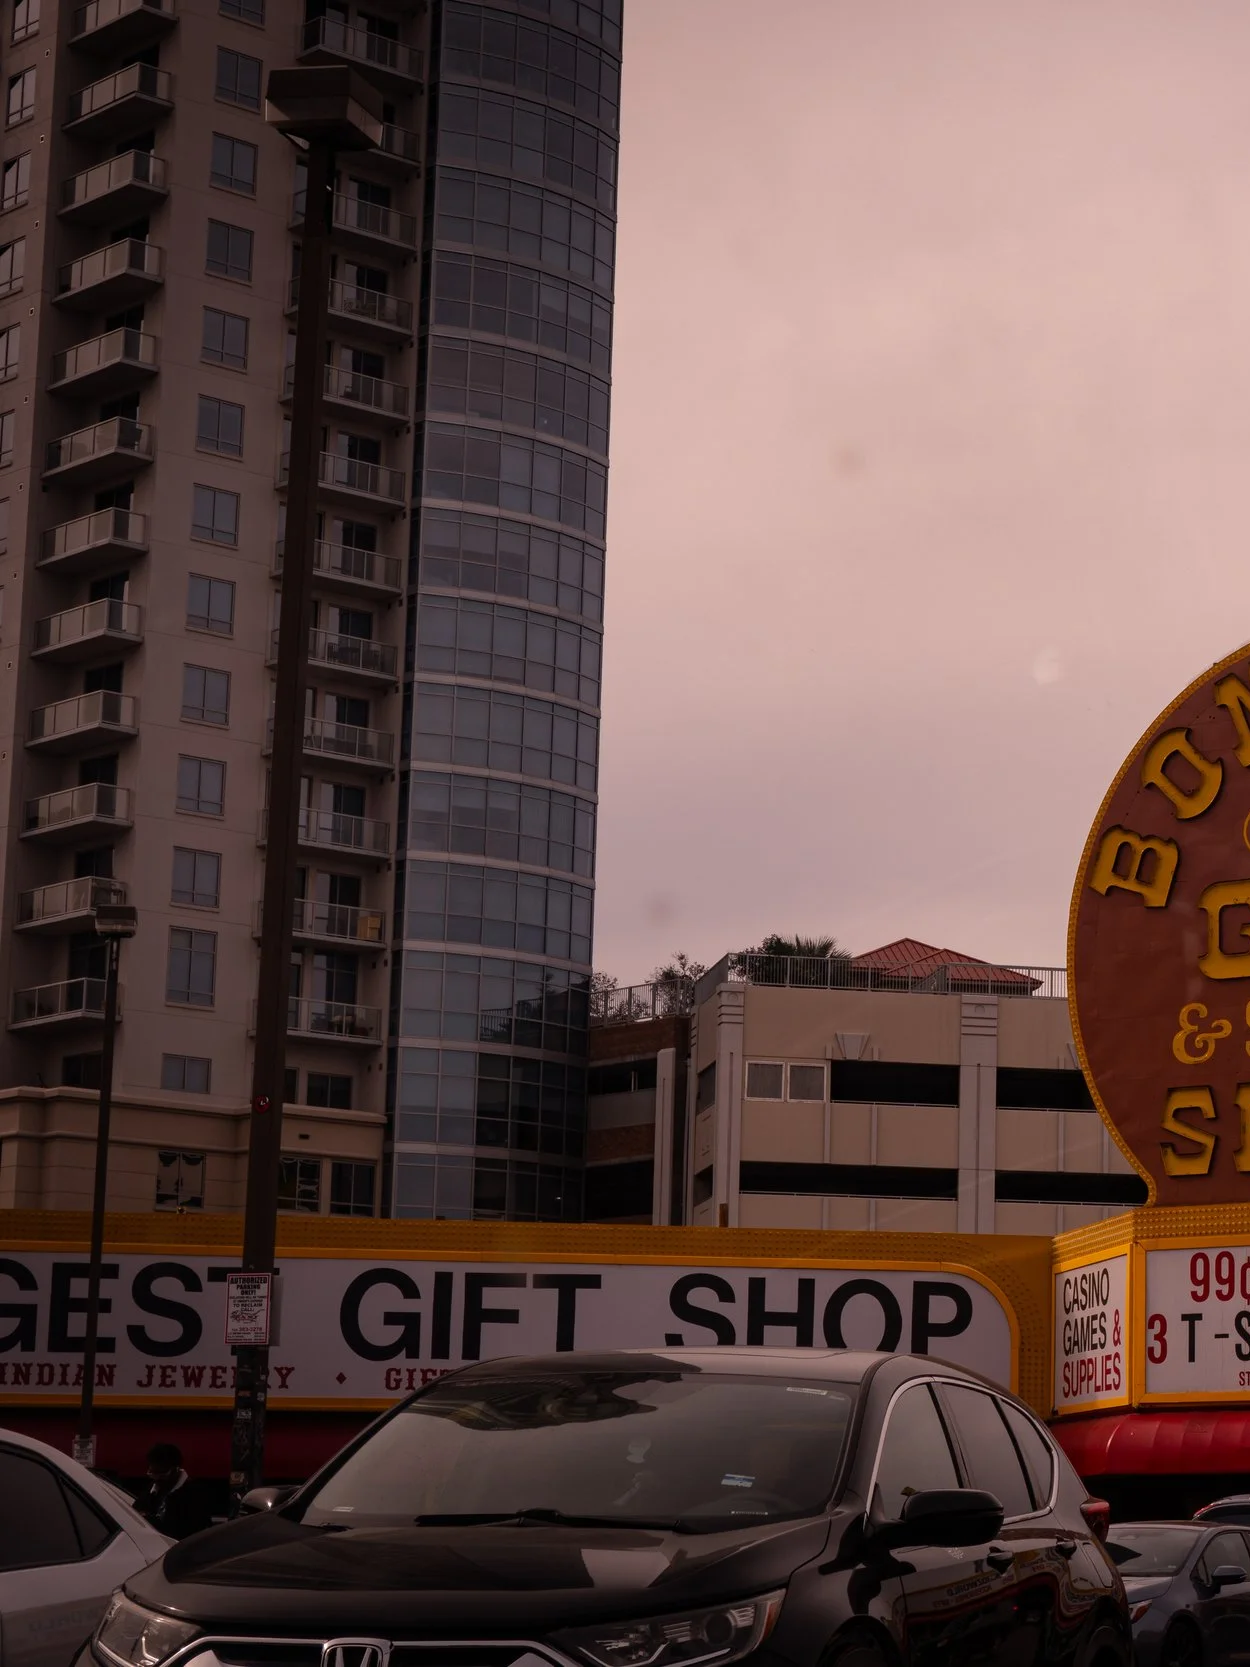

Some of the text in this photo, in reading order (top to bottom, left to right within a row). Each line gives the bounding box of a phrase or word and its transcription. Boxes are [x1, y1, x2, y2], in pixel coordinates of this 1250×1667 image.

[1172, 1003, 1233, 1065] &
[339, 1267, 602, 1362] GIFT
[664, 1273, 973, 1354] SHOP
[1063, 1268, 1110, 1315] CASINO
[1063, 1309, 1121, 1356] GAMES &
[1147, 1313, 1168, 1364] 3
[137, 1364, 295, 1389] JEWEY
[385, 1367, 456, 1391] GIF
[1062, 1352, 1121, 1398] SUPPLIES
